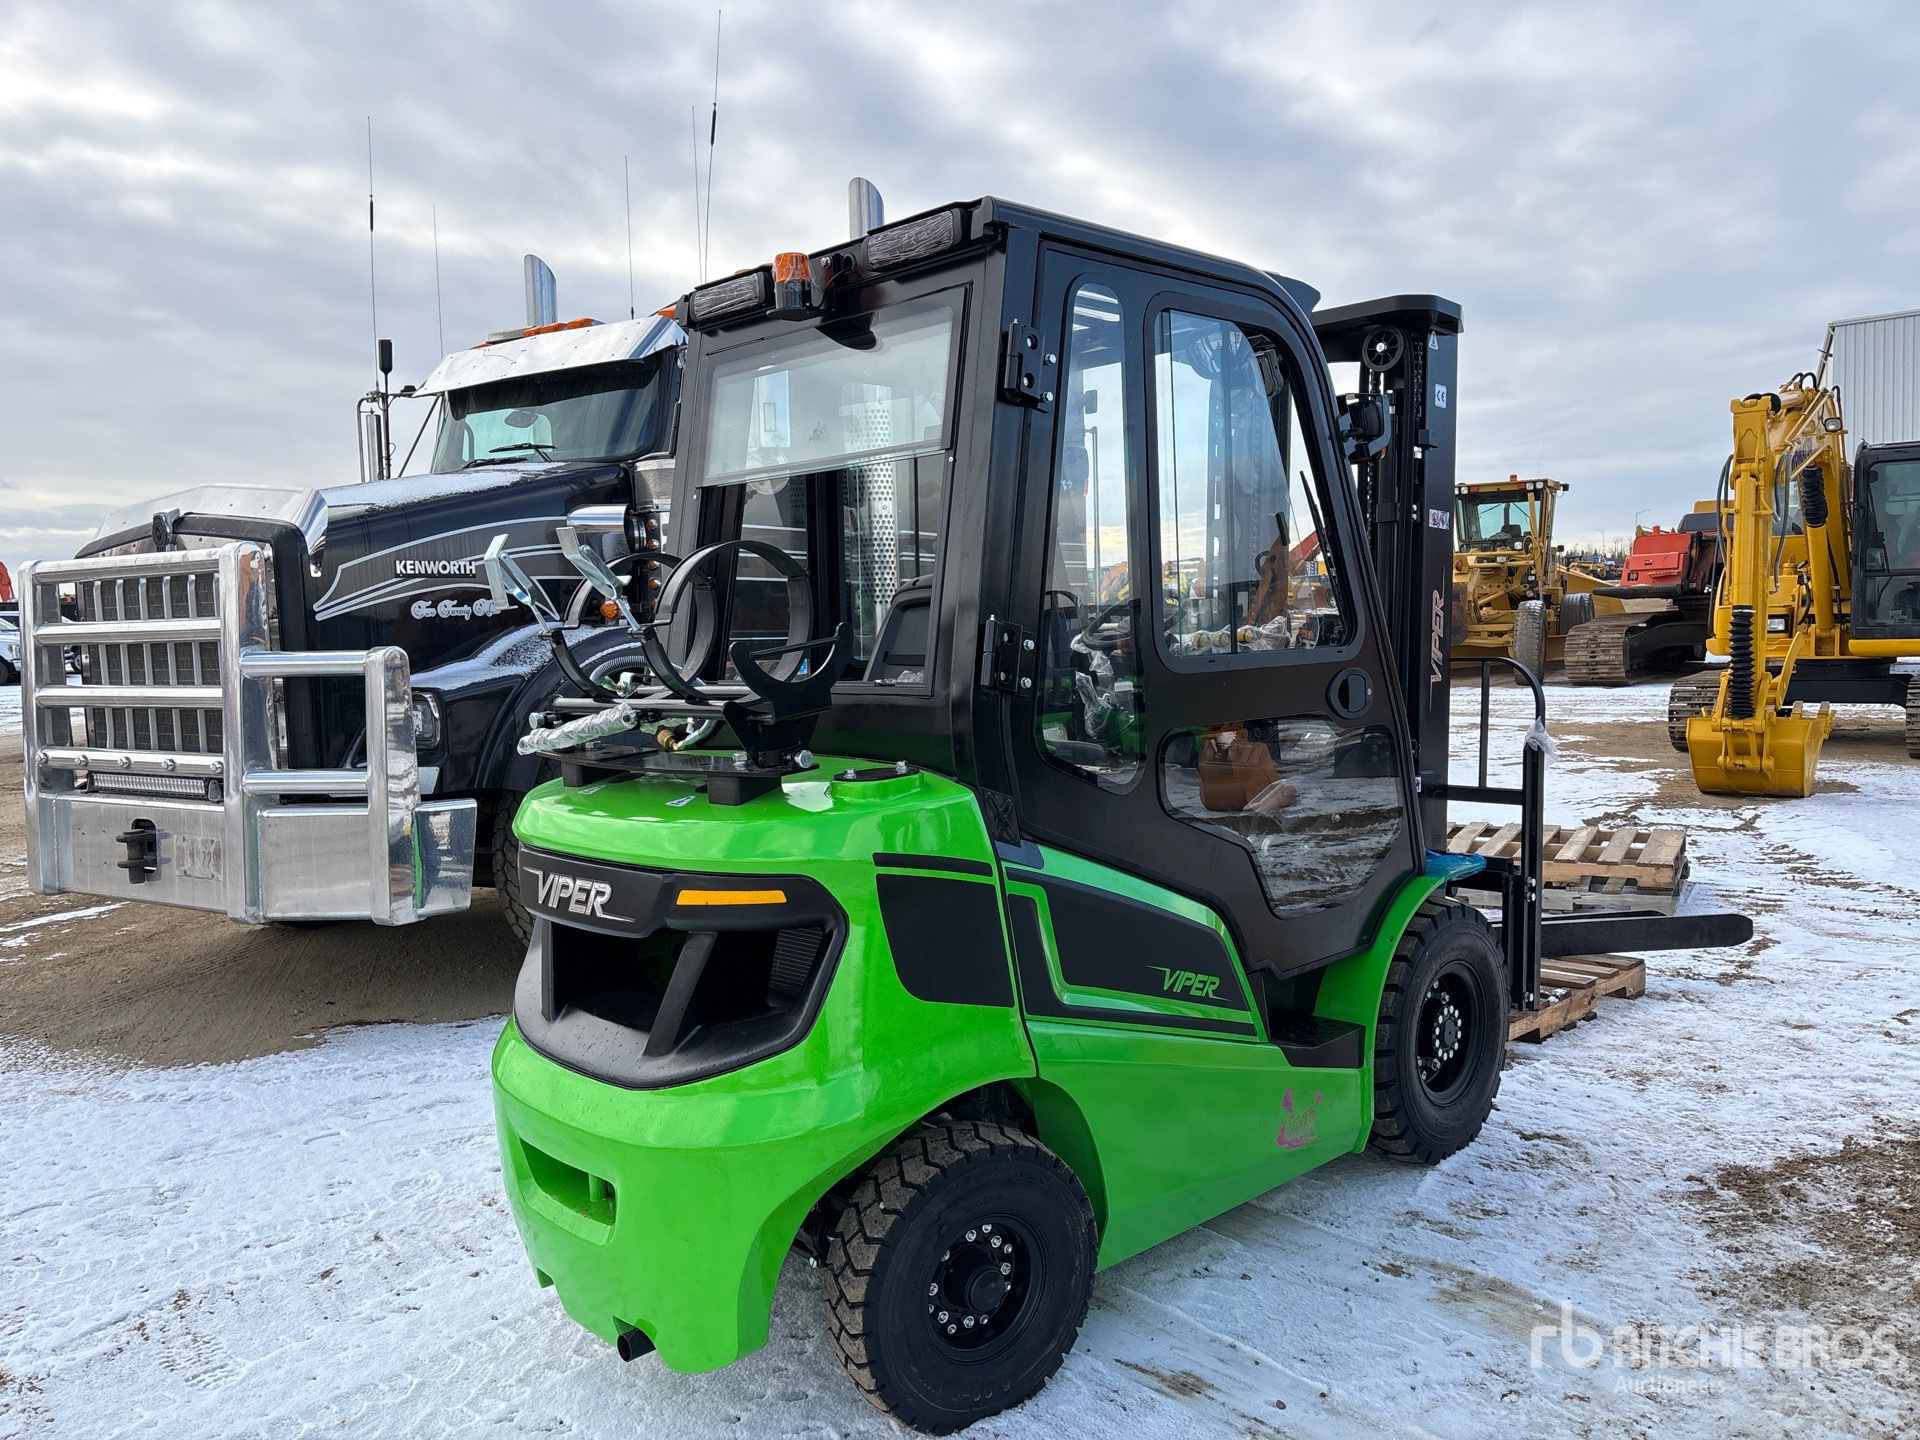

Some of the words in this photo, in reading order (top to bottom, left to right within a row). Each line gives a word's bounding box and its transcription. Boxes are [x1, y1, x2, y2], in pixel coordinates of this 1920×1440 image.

[395, 560, 476, 575] KENWORTH
[1430, 575, 1445, 698] VIPER
[525, 867, 633, 922] VIPER
[1149, 966, 1228, 1000] VIPER
